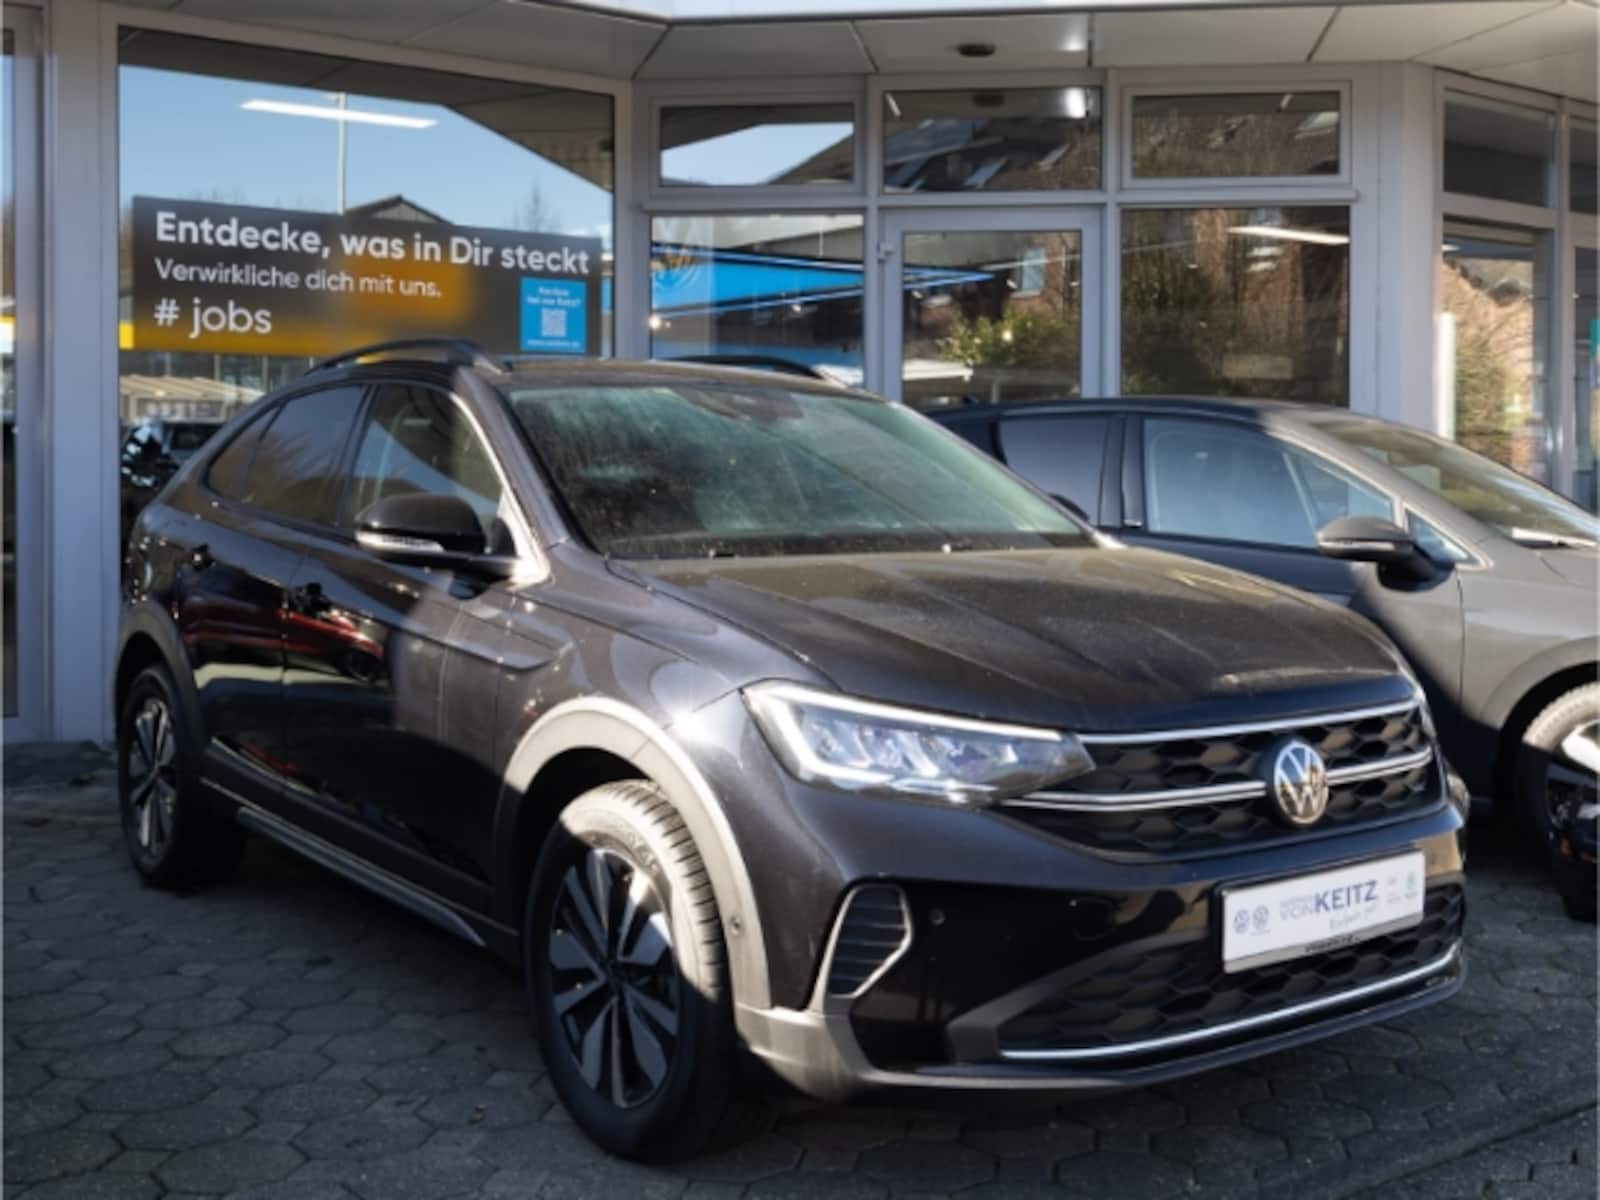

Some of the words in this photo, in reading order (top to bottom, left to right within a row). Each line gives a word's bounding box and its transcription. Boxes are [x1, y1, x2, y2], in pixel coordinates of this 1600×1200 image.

[156, 211, 331, 259] Entdecke,
[340, 234, 405, 260] was
[414, 232, 442, 263] in
[451, 237, 493, 266] Dir
[501, 245, 589, 274] steckt
[154, 258, 299, 289] Verwirkliche
[305, 270, 353, 293] dich
[359, 274, 394, 295] mit
[399, 279, 442, 297] uns.
[189, 297, 272, 339] jobs
